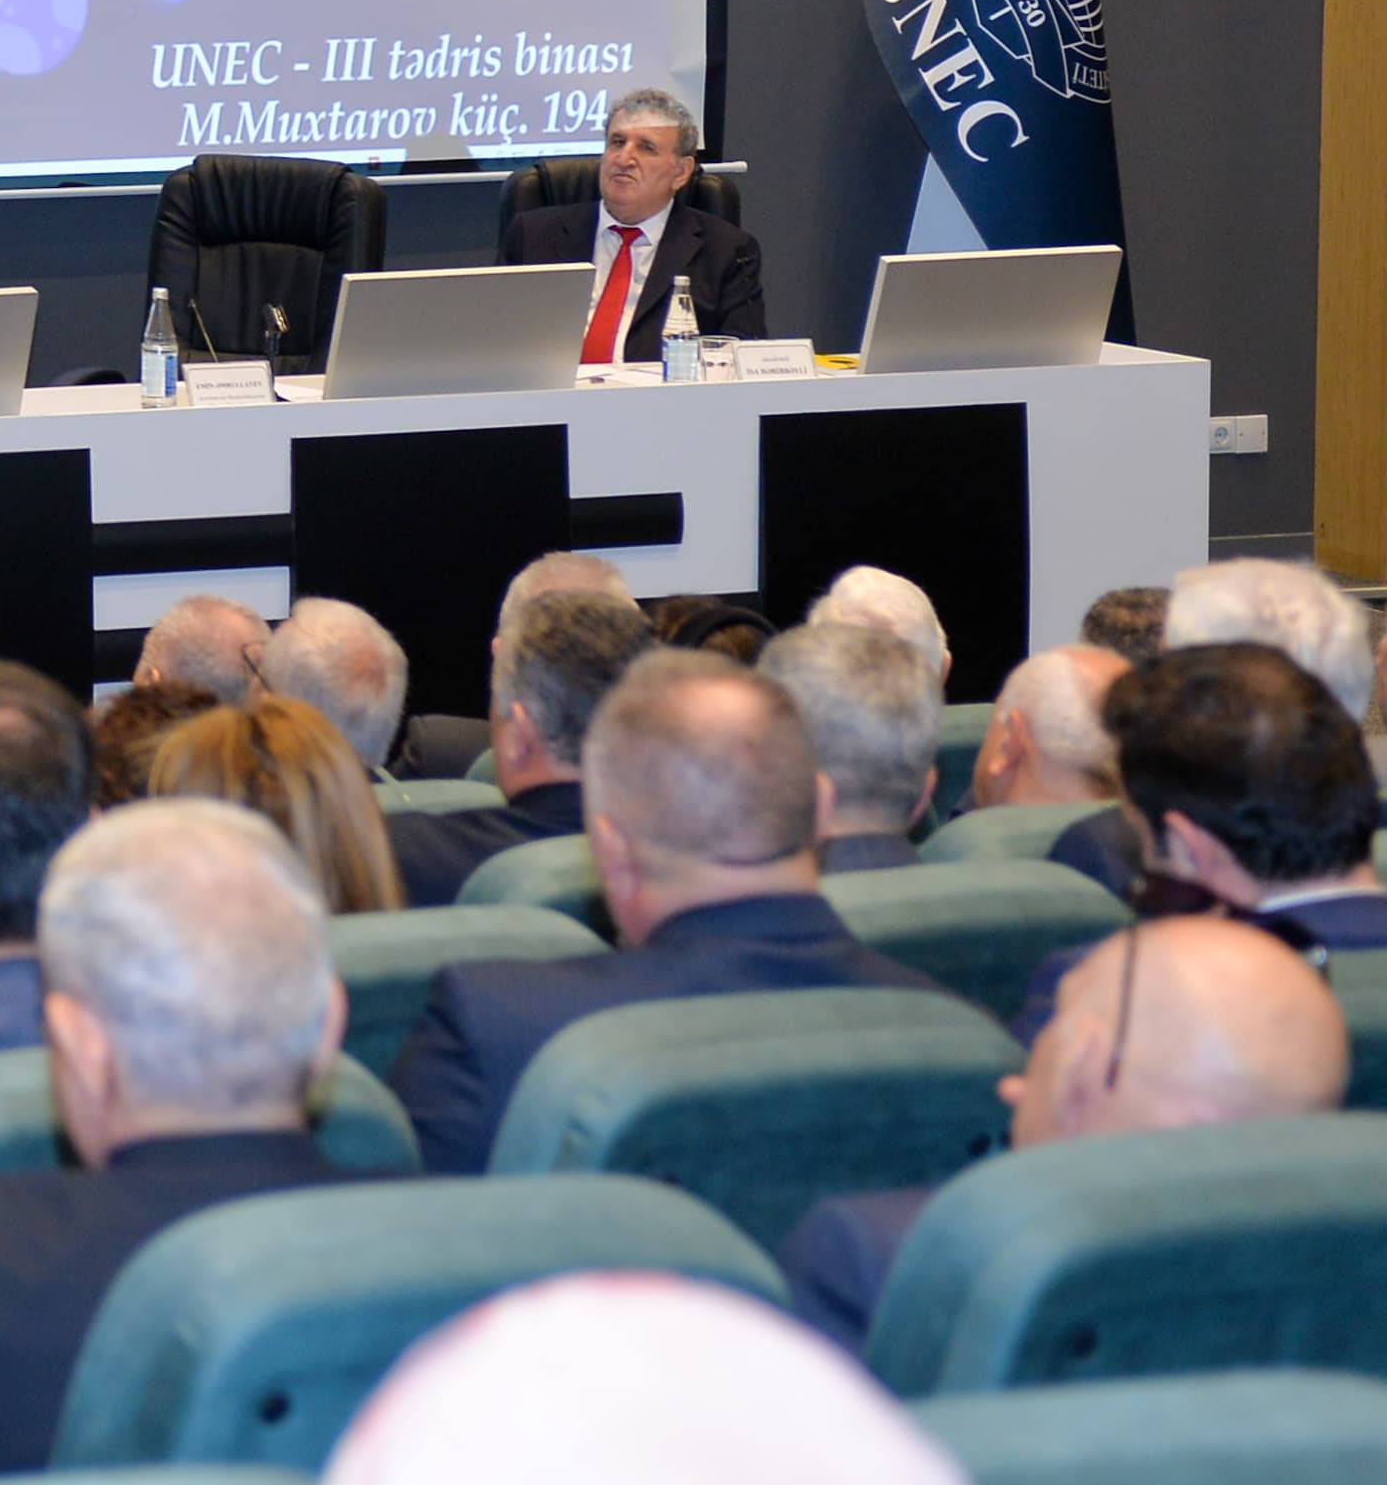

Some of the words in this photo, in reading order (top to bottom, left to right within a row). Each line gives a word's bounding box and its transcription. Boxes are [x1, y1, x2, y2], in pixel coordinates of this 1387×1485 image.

[151, 40, 283, 88] UNEC
[321, 37, 378, 83] III
[387, 33, 503, 82] tədris
[514, 30, 635, 77] binası
[176, 98, 437, 148] M.Muxtarov
[448, 91, 528, 146] küç.
[541, 88, 609, 134] 194
